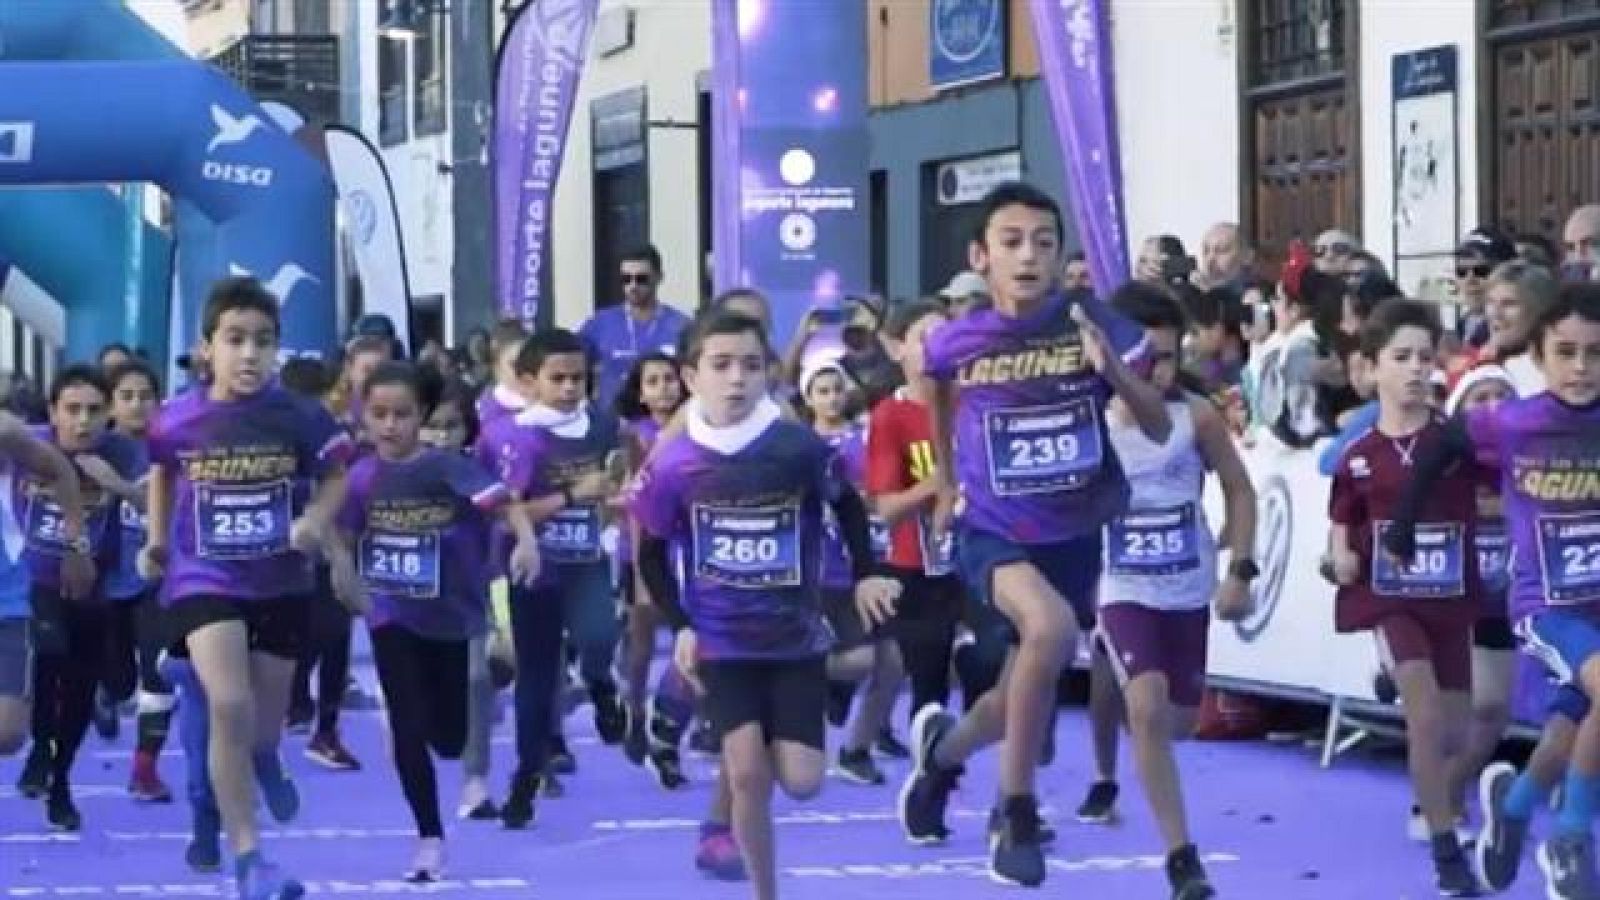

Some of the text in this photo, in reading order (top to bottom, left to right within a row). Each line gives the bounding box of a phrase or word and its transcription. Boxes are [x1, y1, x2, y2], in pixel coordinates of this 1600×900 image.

[1010, 434, 1078, 466] 239
[214, 511, 273, 536] 253
[712, 536, 778, 563] 260
[1124, 530, 1184, 556] 235
